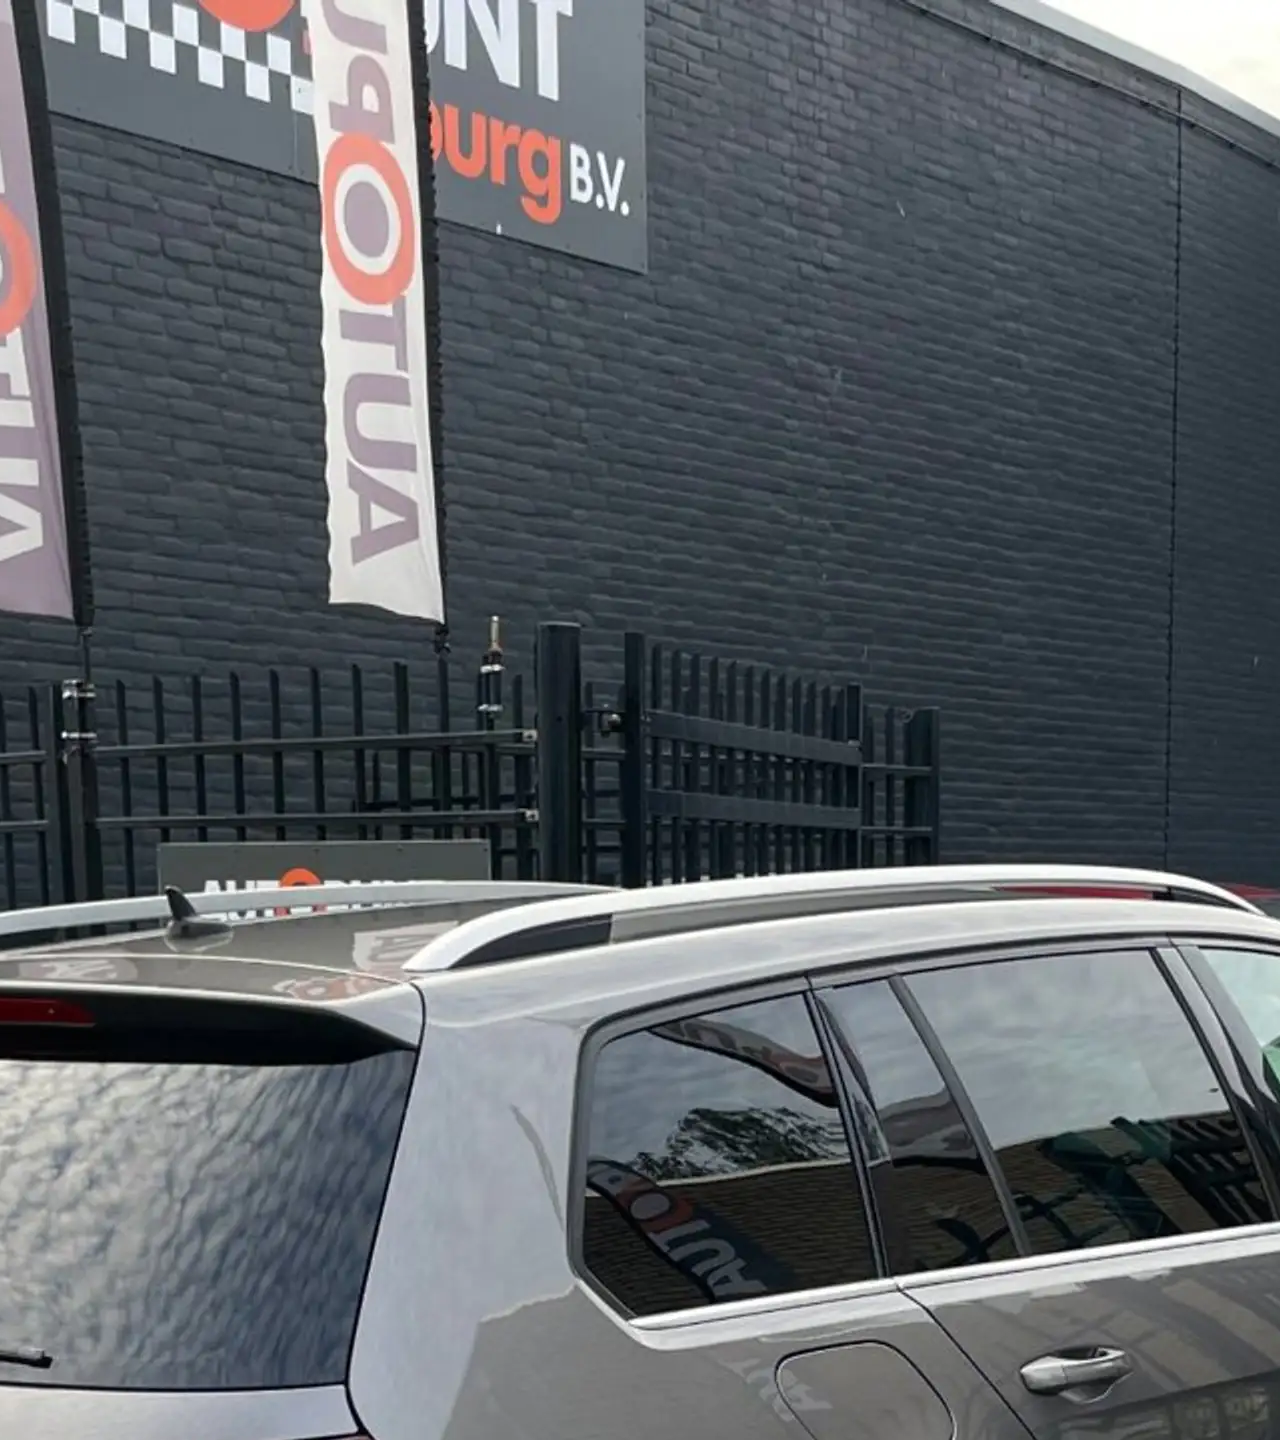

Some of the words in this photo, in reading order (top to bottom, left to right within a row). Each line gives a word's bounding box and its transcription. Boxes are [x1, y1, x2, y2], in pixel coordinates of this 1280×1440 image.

[424, 0, 573, 101] NT
[428, 99, 563, 225] urg
[570, 142, 630, 217] B.V.
